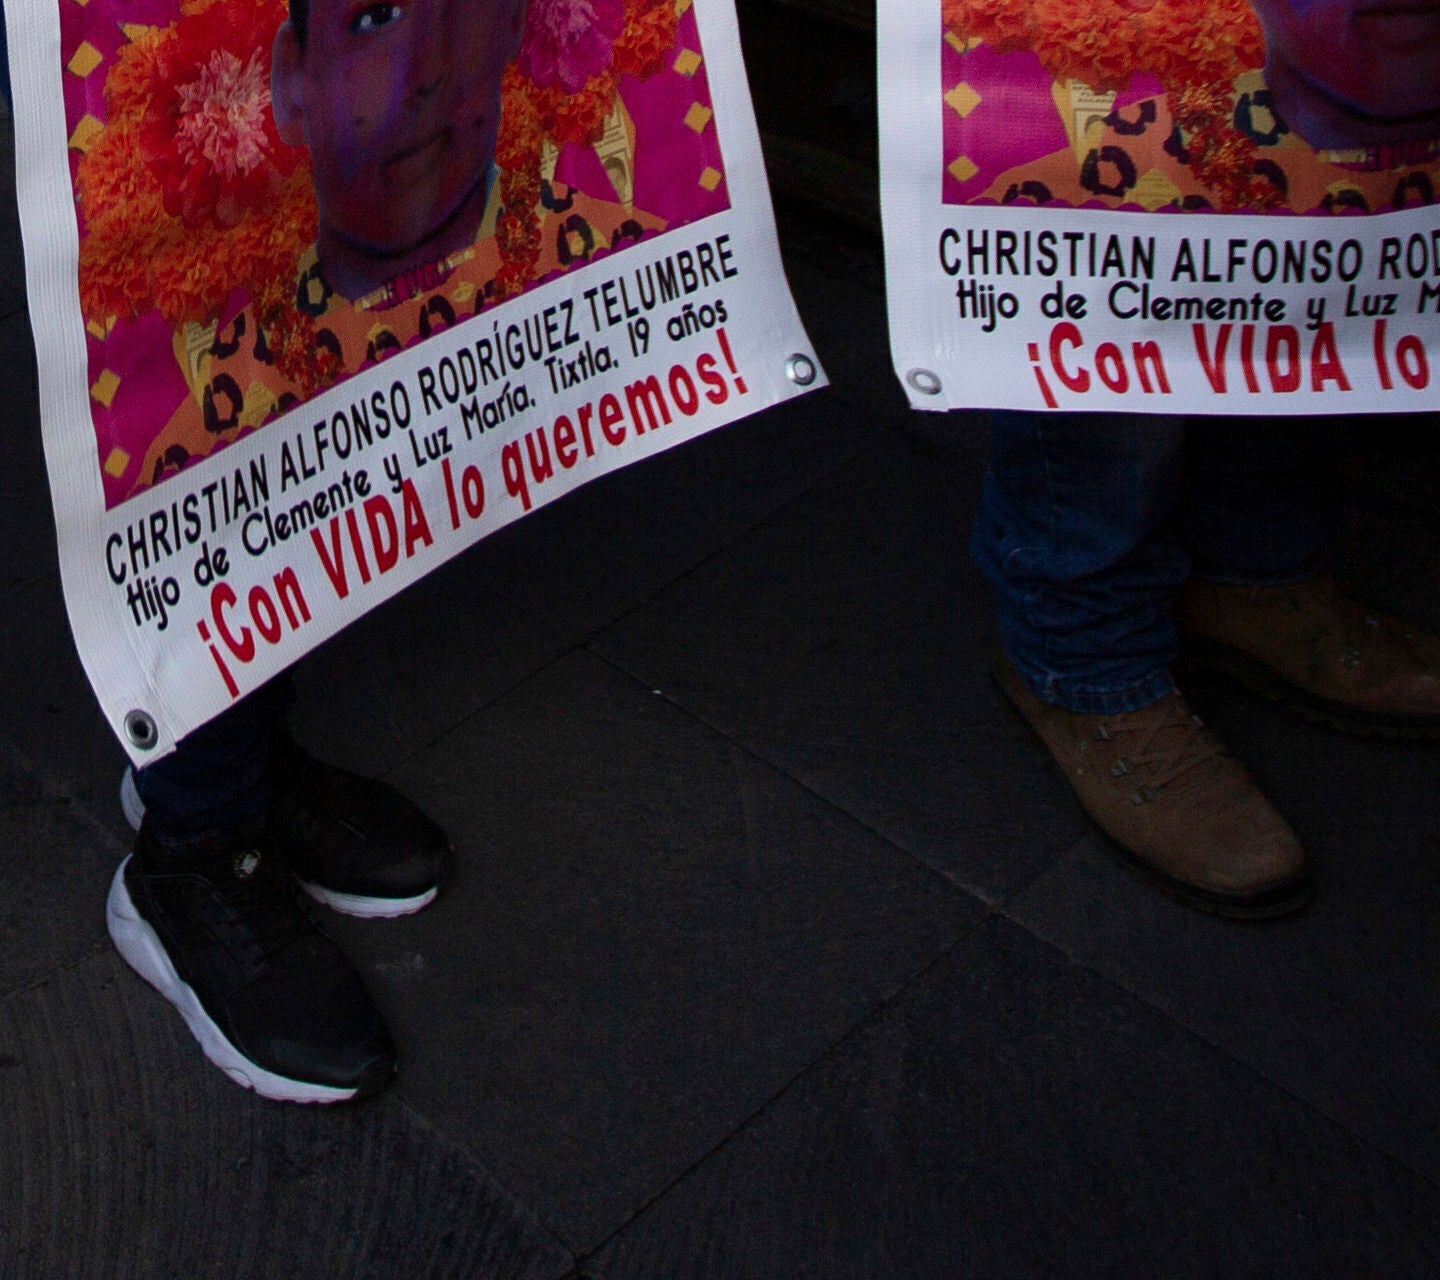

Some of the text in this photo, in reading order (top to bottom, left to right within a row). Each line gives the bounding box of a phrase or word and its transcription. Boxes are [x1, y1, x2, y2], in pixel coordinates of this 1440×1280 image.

[939, 226, 1158, 282] CHRISTIAN
[1170, 236, 1365, 285] ALFONSO
[955, 278, 1021, 334] Hijo
[1039, 279, 1089, 322] de
[1107, 279, 1288, 324] Clemente
[1305, 296, 1328, 332] y
[1344, 283, 1400, 318] Luz
[105, 233, 739, 586] CHRISTIAN ALFONSO RODRÍGUEZ TELUMBRE
[126, 575, 181, 632] Hijo
[192, 540, 231, 587] de
[240, 468, 372, 557] Clemente
[382, 453, 405, 494] y
[408, 425, 454, 468] Luz
[626, 316, 651, 359] 19
[665, 297, 729, 343] años
[1026, 320, 1173, 410] ¡Con
[1190, 321, 1354, 395] VIDA
[1372, 316, 1431, 392] lo
[195, 326, 750, 700] ¡Con VIDA lo queremos!
